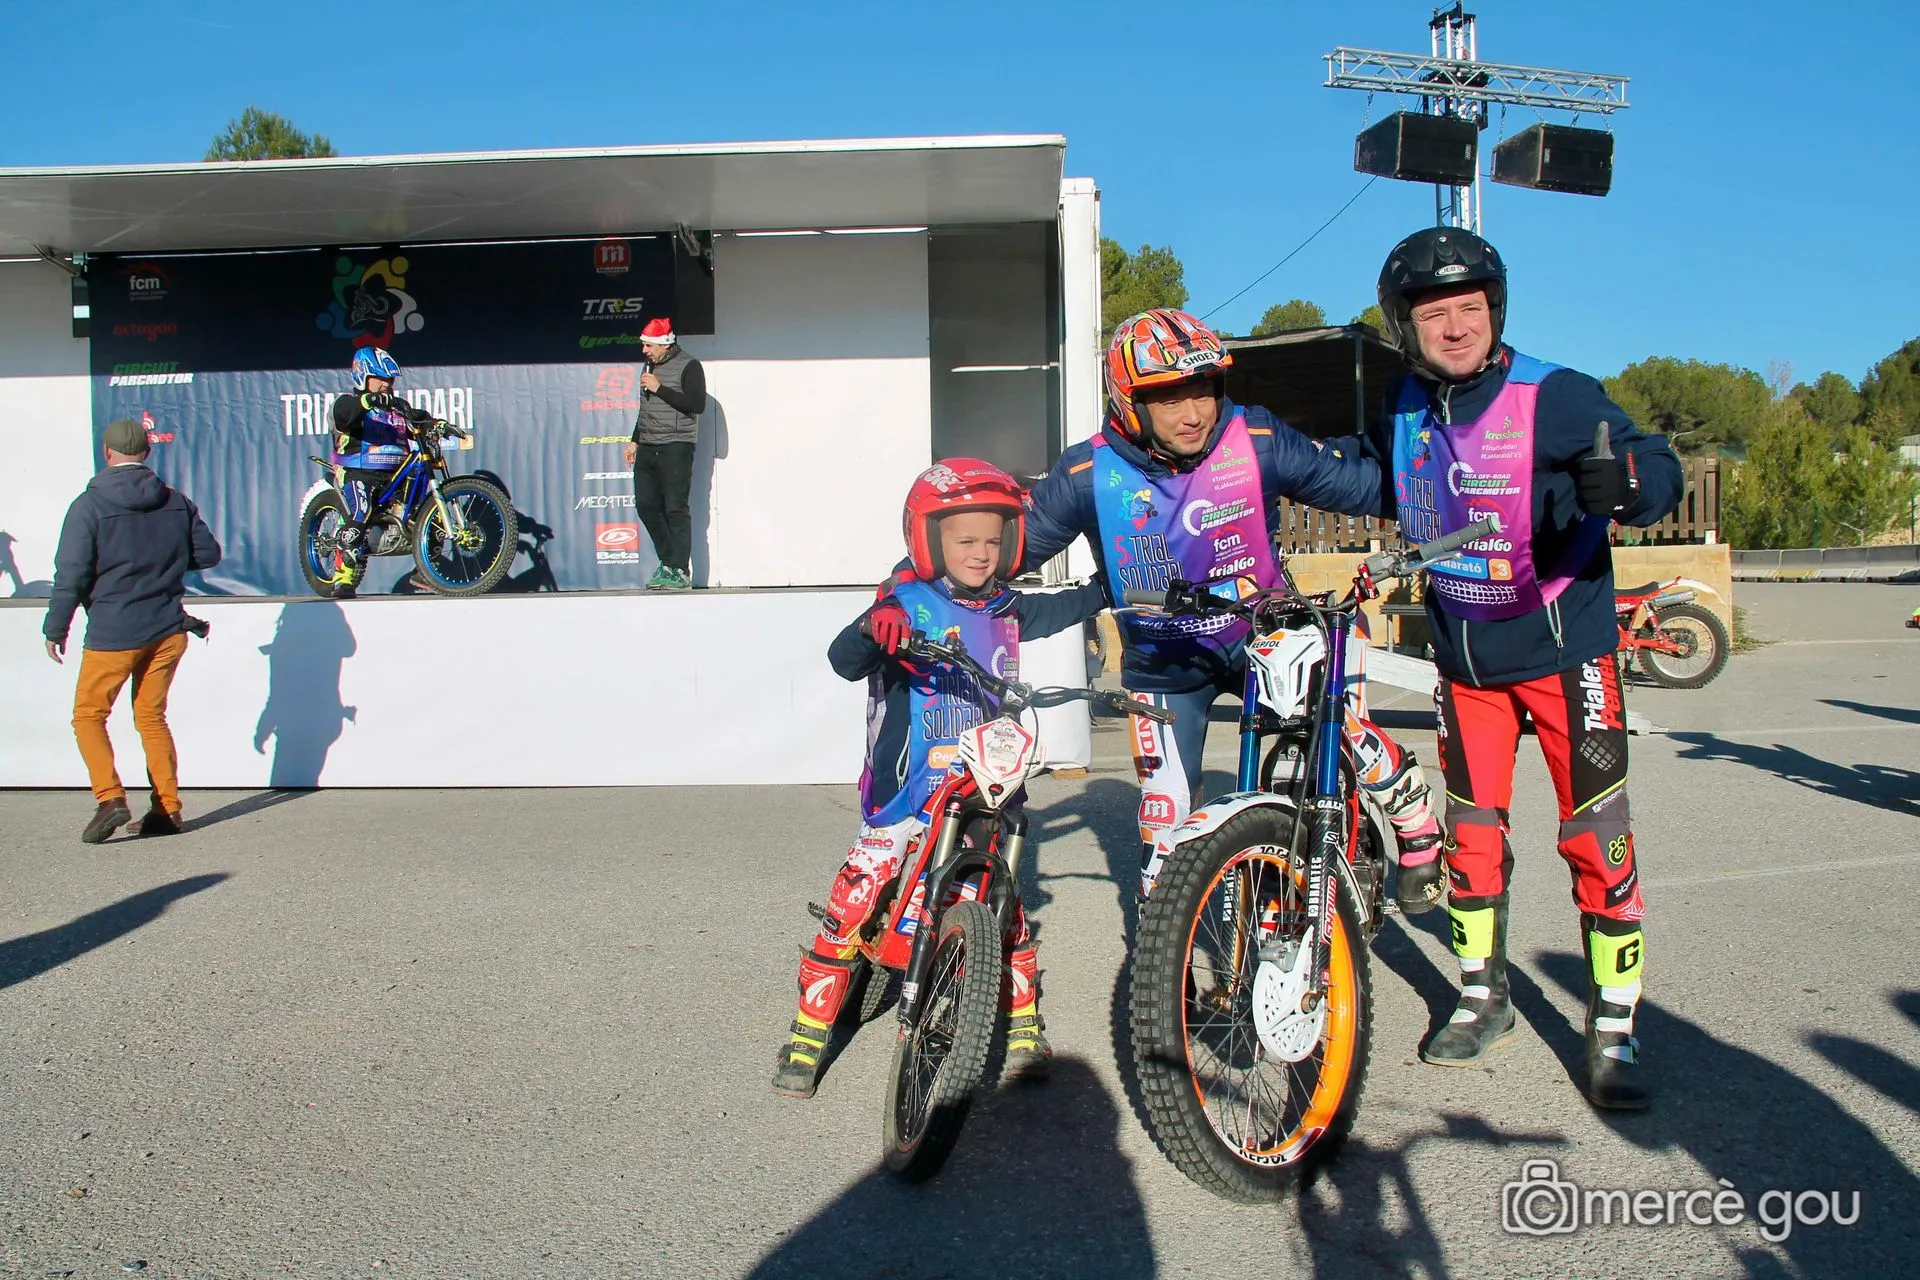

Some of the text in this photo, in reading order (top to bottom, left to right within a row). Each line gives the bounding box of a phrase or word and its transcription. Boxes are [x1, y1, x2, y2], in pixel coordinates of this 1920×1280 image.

[129, 275, 160, 290] fcm
[1184, 352, 1215, 367] SHOEI
[113, 362, 179, 375] CIRCUIT
[109, 373, 194, 387] PARCMOTOR
[280, 394, 336, 436] TRIA
[583, 472, 634, 480] SCORP
[1458, 487, 1520, 496] PARCMOTOR
[574, 495, 636, 511] MECATEC
[1200, 507, 1255, 531] PARCMOTOR
[1201, 503, 1246, 523] CIRCUIT
[1467, 508, 1499, 523] fcm
[1213, 533, 1241, 553] fcm
[596, 551, 639, 560] Beta
[1208, 556, 1256, 578] TrialGo
[1251, 640, 1280, 649] REPSOL
[1580, 658, 1609, 732] Trialer
[1309, 856, 1322, 905] BRAKTEC
